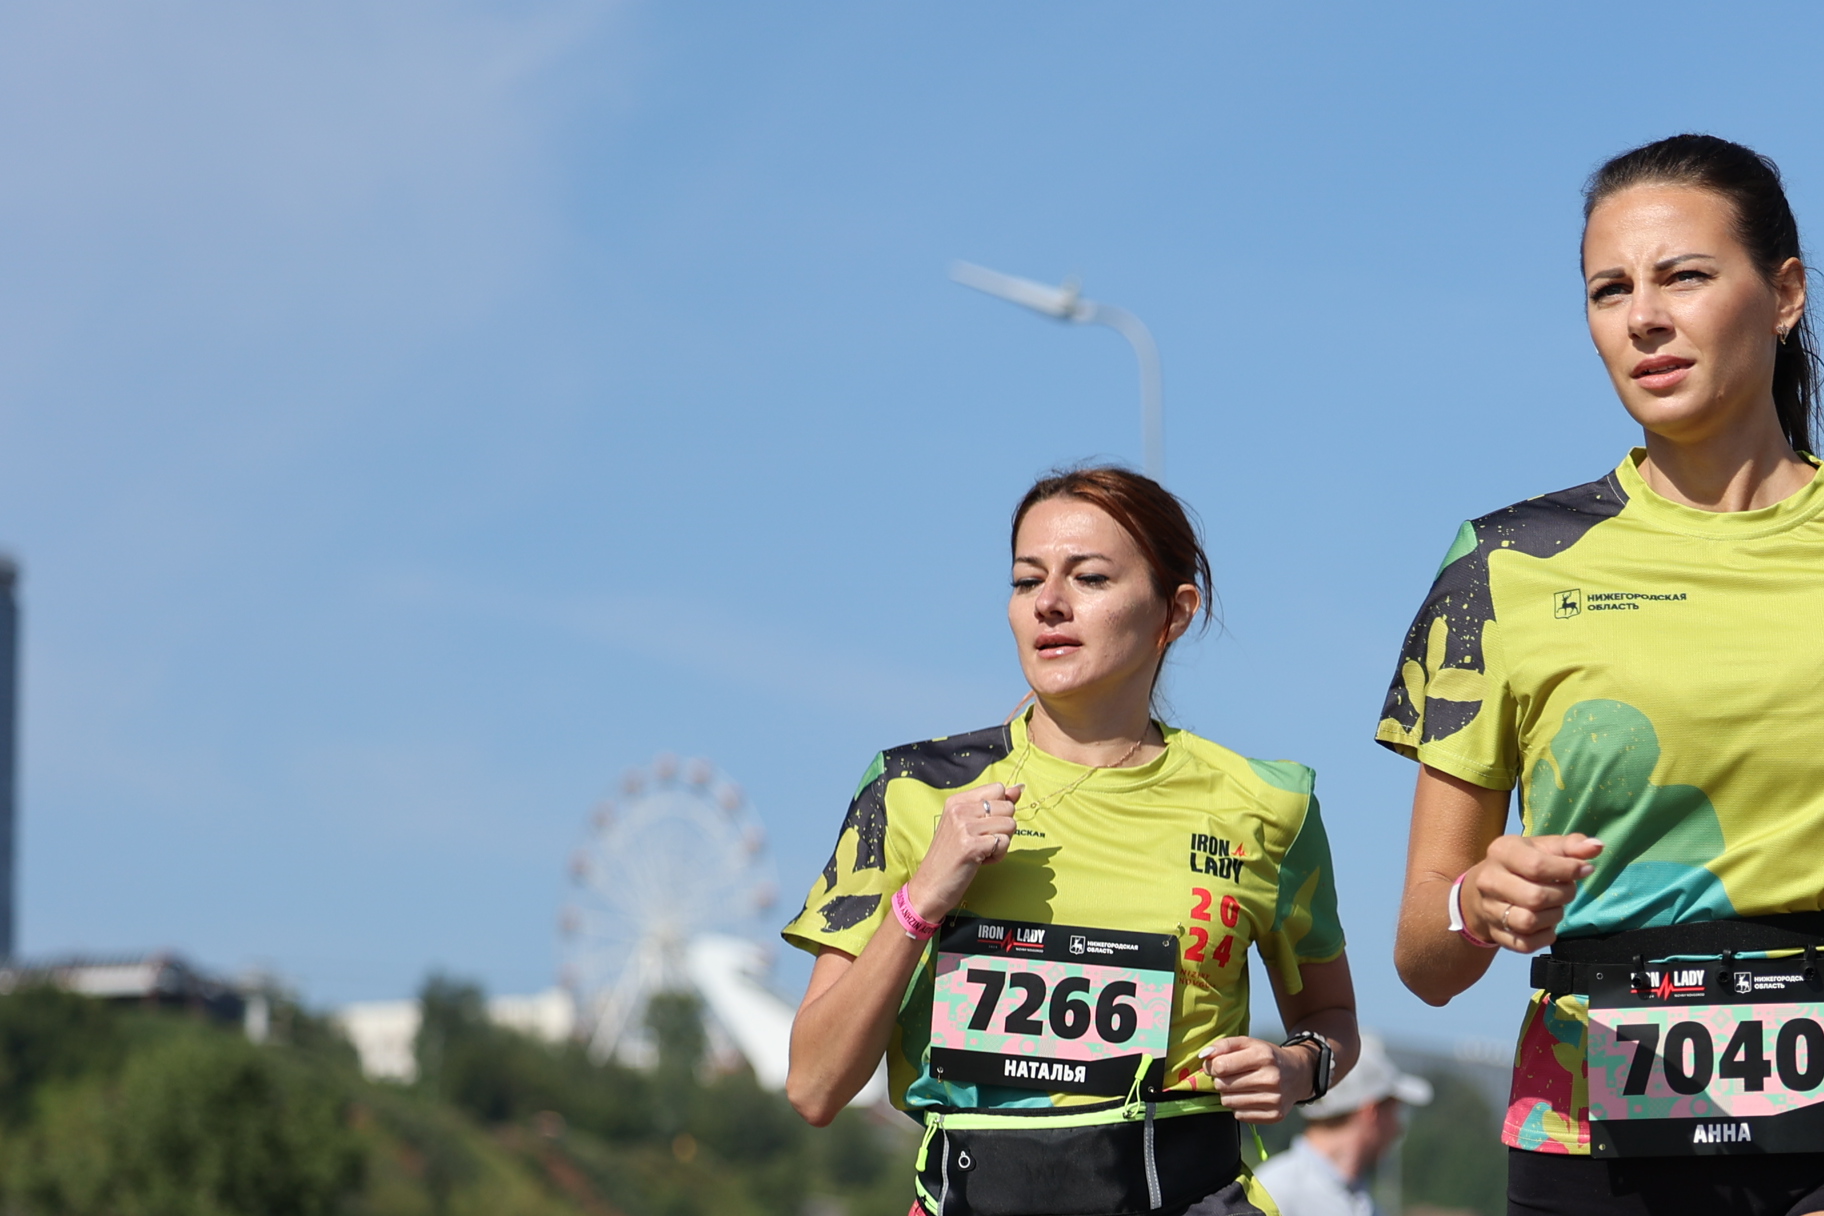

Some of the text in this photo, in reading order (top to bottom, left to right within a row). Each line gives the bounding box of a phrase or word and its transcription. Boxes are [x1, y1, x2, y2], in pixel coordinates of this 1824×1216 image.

[1587, 593, 1687, 602] НИЖЕГОРОДСКАЯ
[1587, 602, 1640, 611] ОБЛАСТЬ
[1191, 833, 1230, 857] IRON
[1190, 852, 1244, 884] LADY
[1190, 887, 1241, 928] 20
[978, 924, 1046, 944] IRON LADY
[1184, 926, 1234, 968] 24
[1673, 970, 1705, 987] LADY
[966, 968, 1138, 1044] 7266
[1004, 1059, 1087, 1083] НАТАЛЬЯ
[1693, 1122, 1751, 1143] АННА
